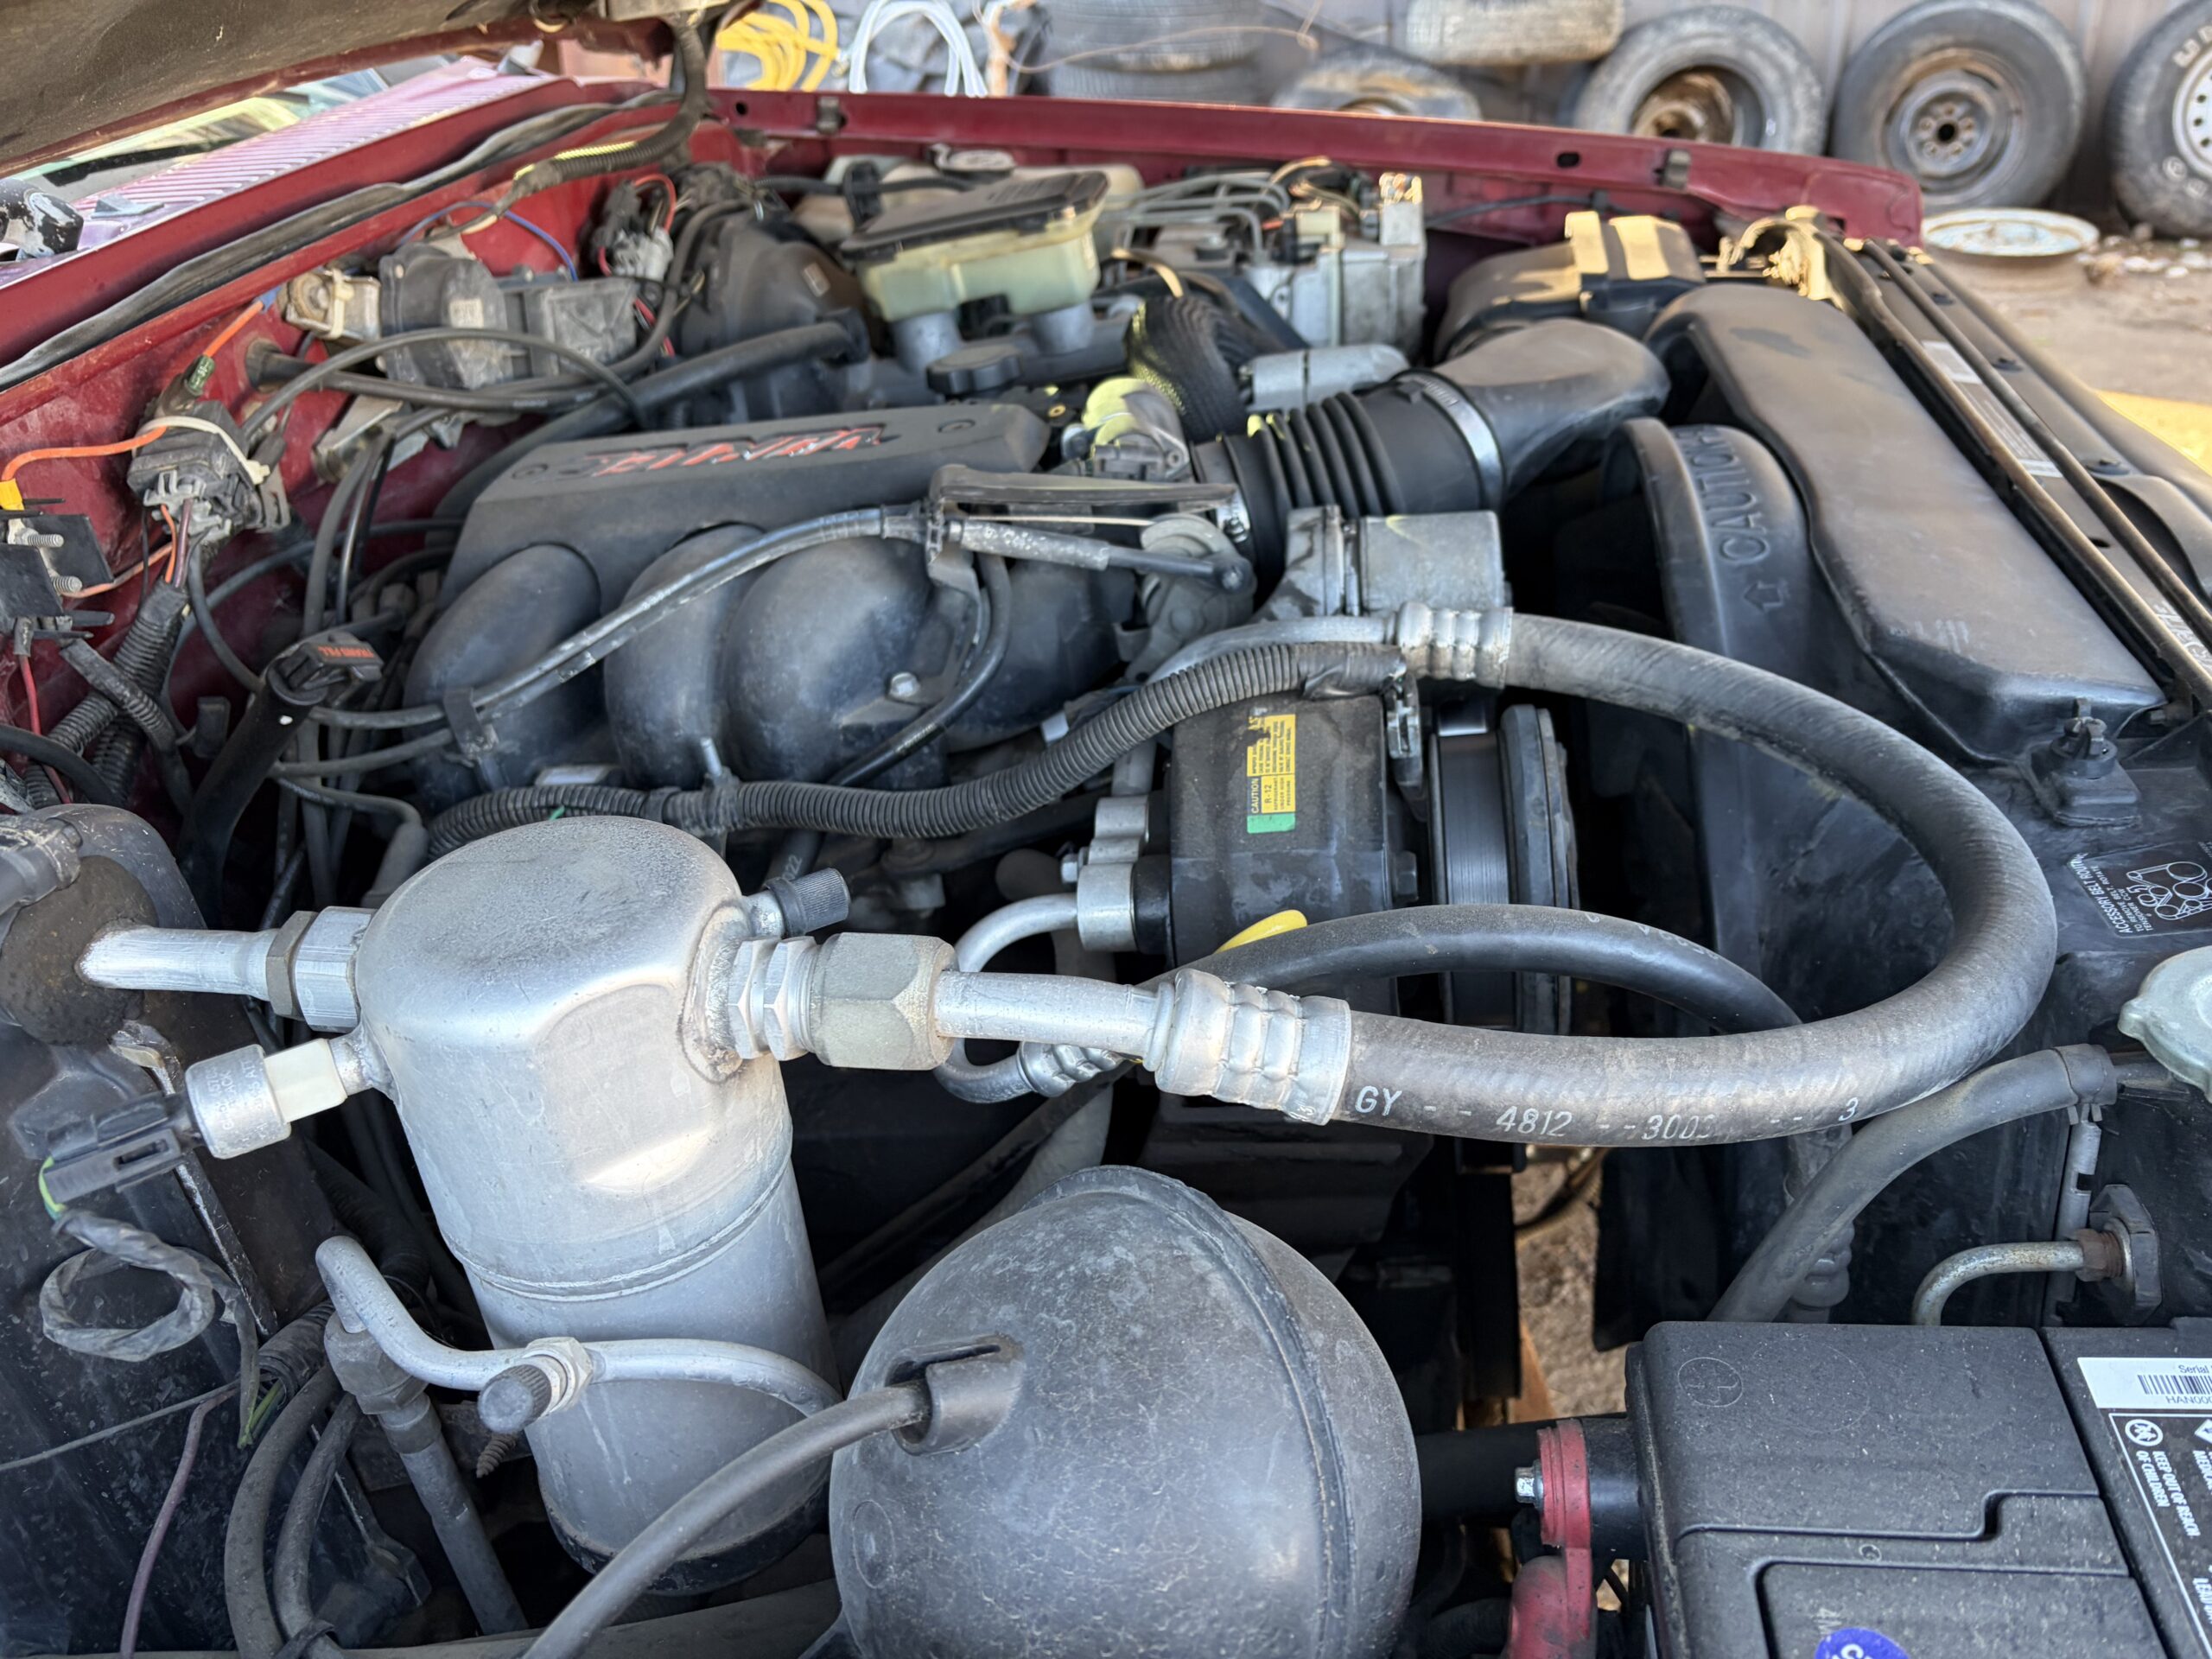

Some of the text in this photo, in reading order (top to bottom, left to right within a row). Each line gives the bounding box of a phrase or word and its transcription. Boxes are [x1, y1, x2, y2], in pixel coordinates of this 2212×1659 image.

[1675, 431, 1770, 563] CAUTION
[2083, 880, 2105, 897] BELT
[2090, 865, 2110, 885] ROTATE
[2097, 897, 2133, 933] ACCESSORY
[2118, 888, 2154, 931] TENSIONER CCW
[2118, 900, 2139, 924] REMOVE
[2134, 923, 2145, 932] TO
[1355, 1085, 1402, 1116] GY
[1496, 1106, 1573, 1136] 4812
[2178, 1364, 2209, 1374] Serial
[2136, 1450, 2171, 1507] OF CHILDREN
[2152, 1451, 2201, 1536] KEEP OUT OF REACH
